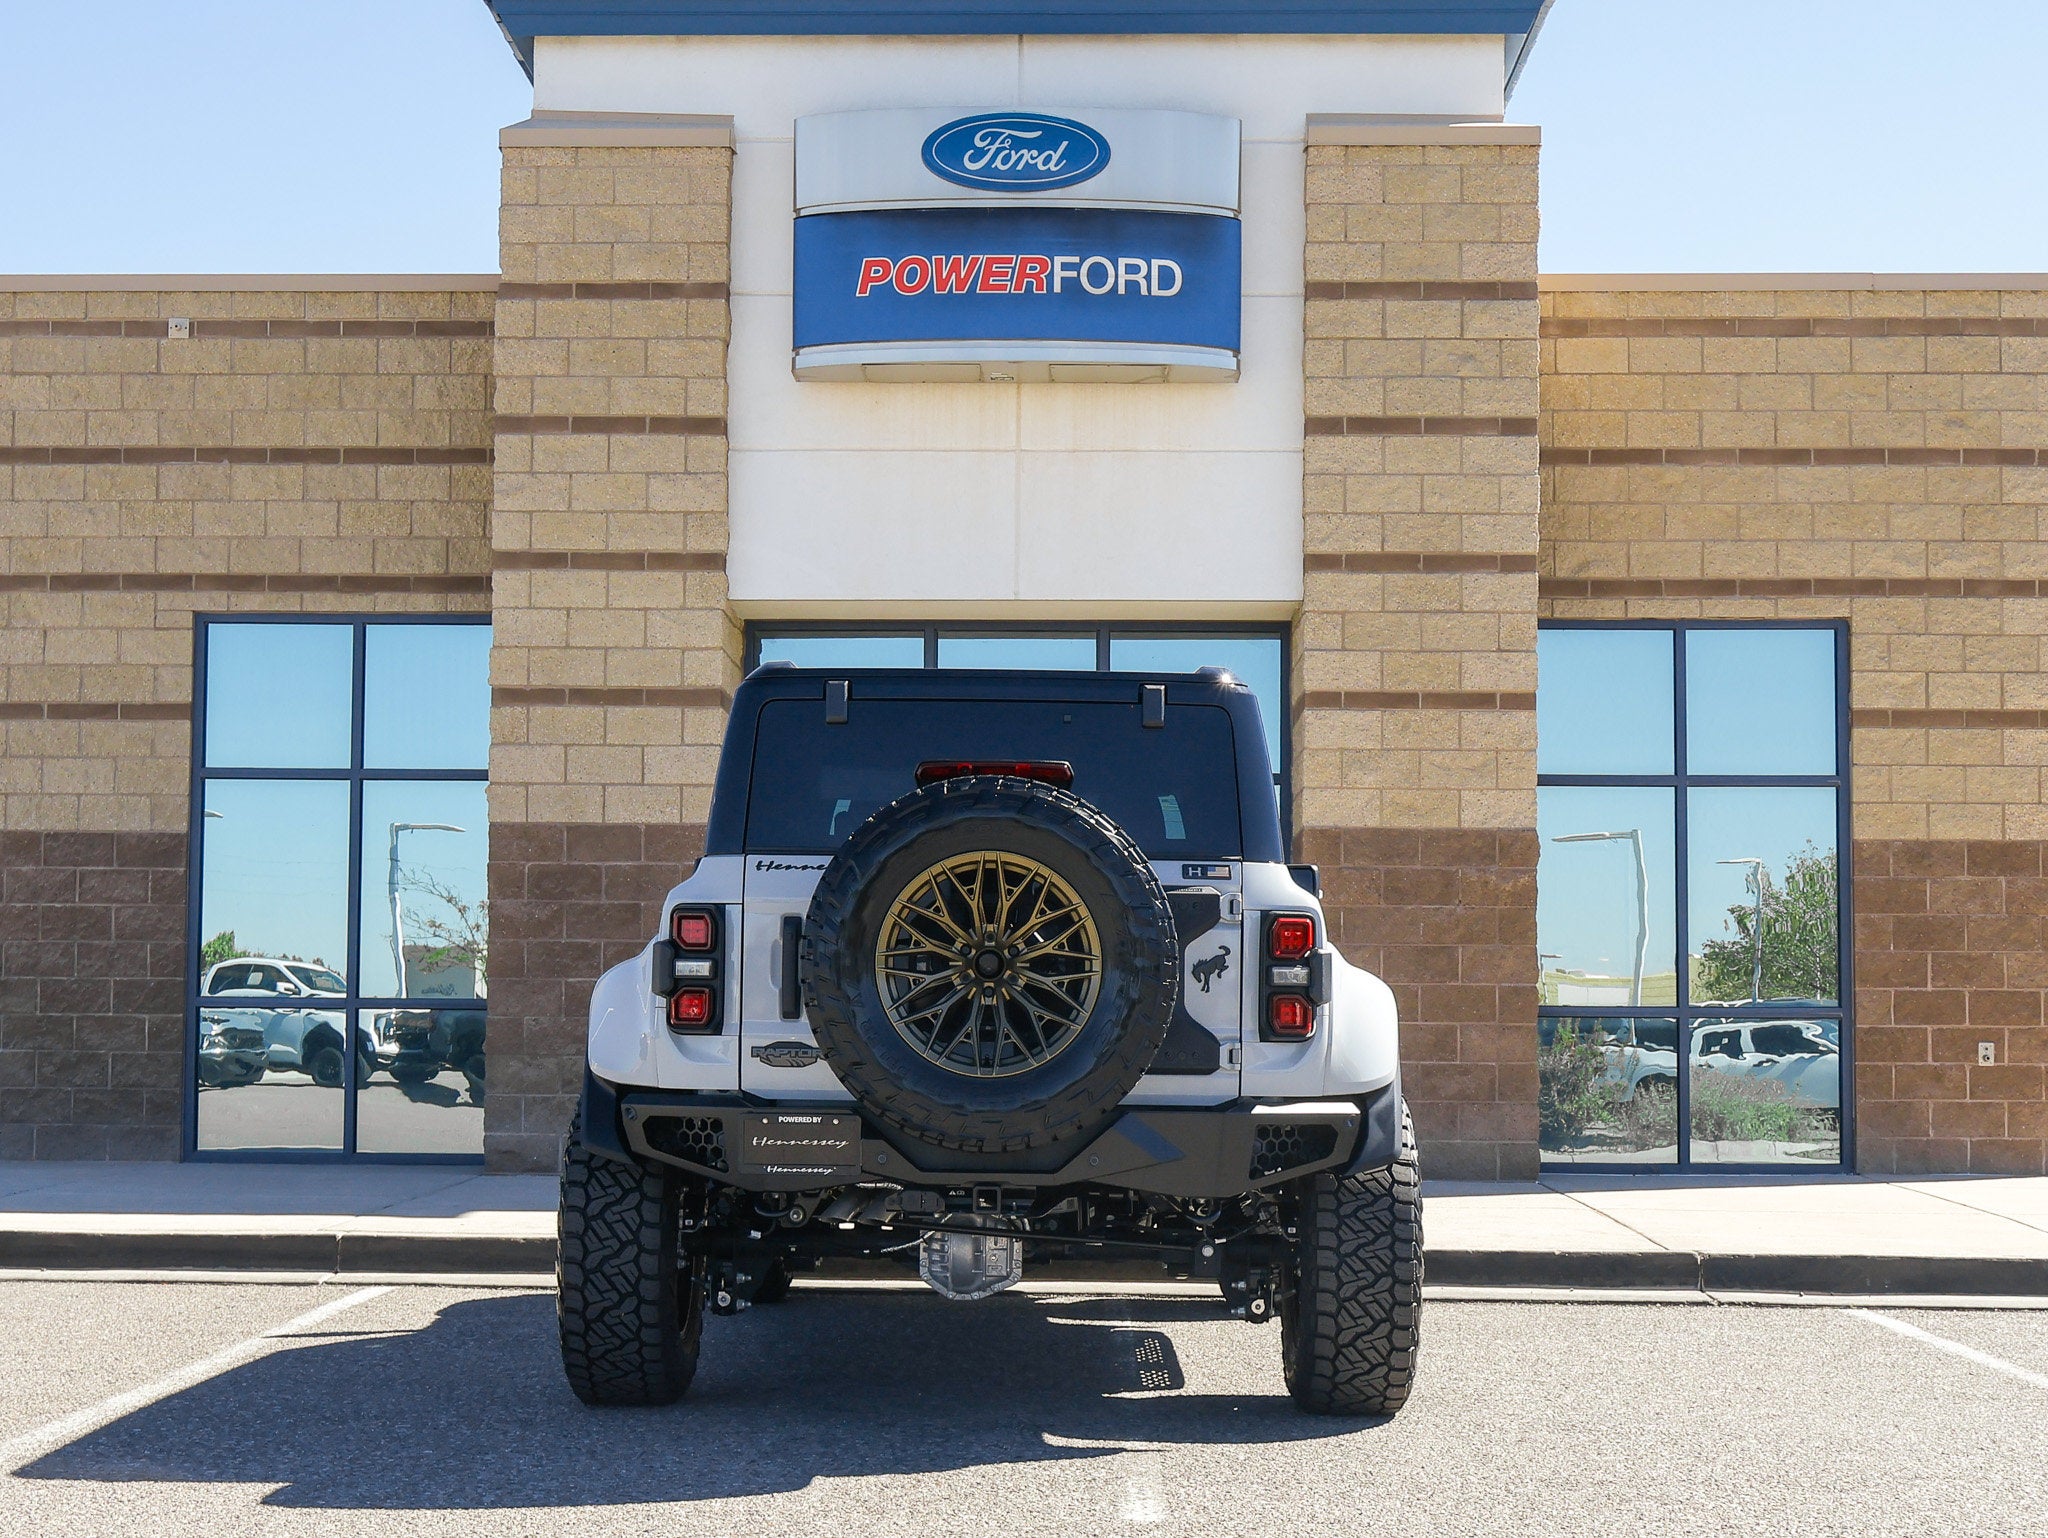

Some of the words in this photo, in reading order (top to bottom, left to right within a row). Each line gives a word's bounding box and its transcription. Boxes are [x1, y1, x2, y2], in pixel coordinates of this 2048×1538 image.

[963, 128, 1069, 173] Ford
[755, 860, 827, 871] Henne
[1188, 866, 1202, 876] H
[752, 1136, 849, 1148] Hennessey
[767, 1165, 834, 1175] Hennessey
